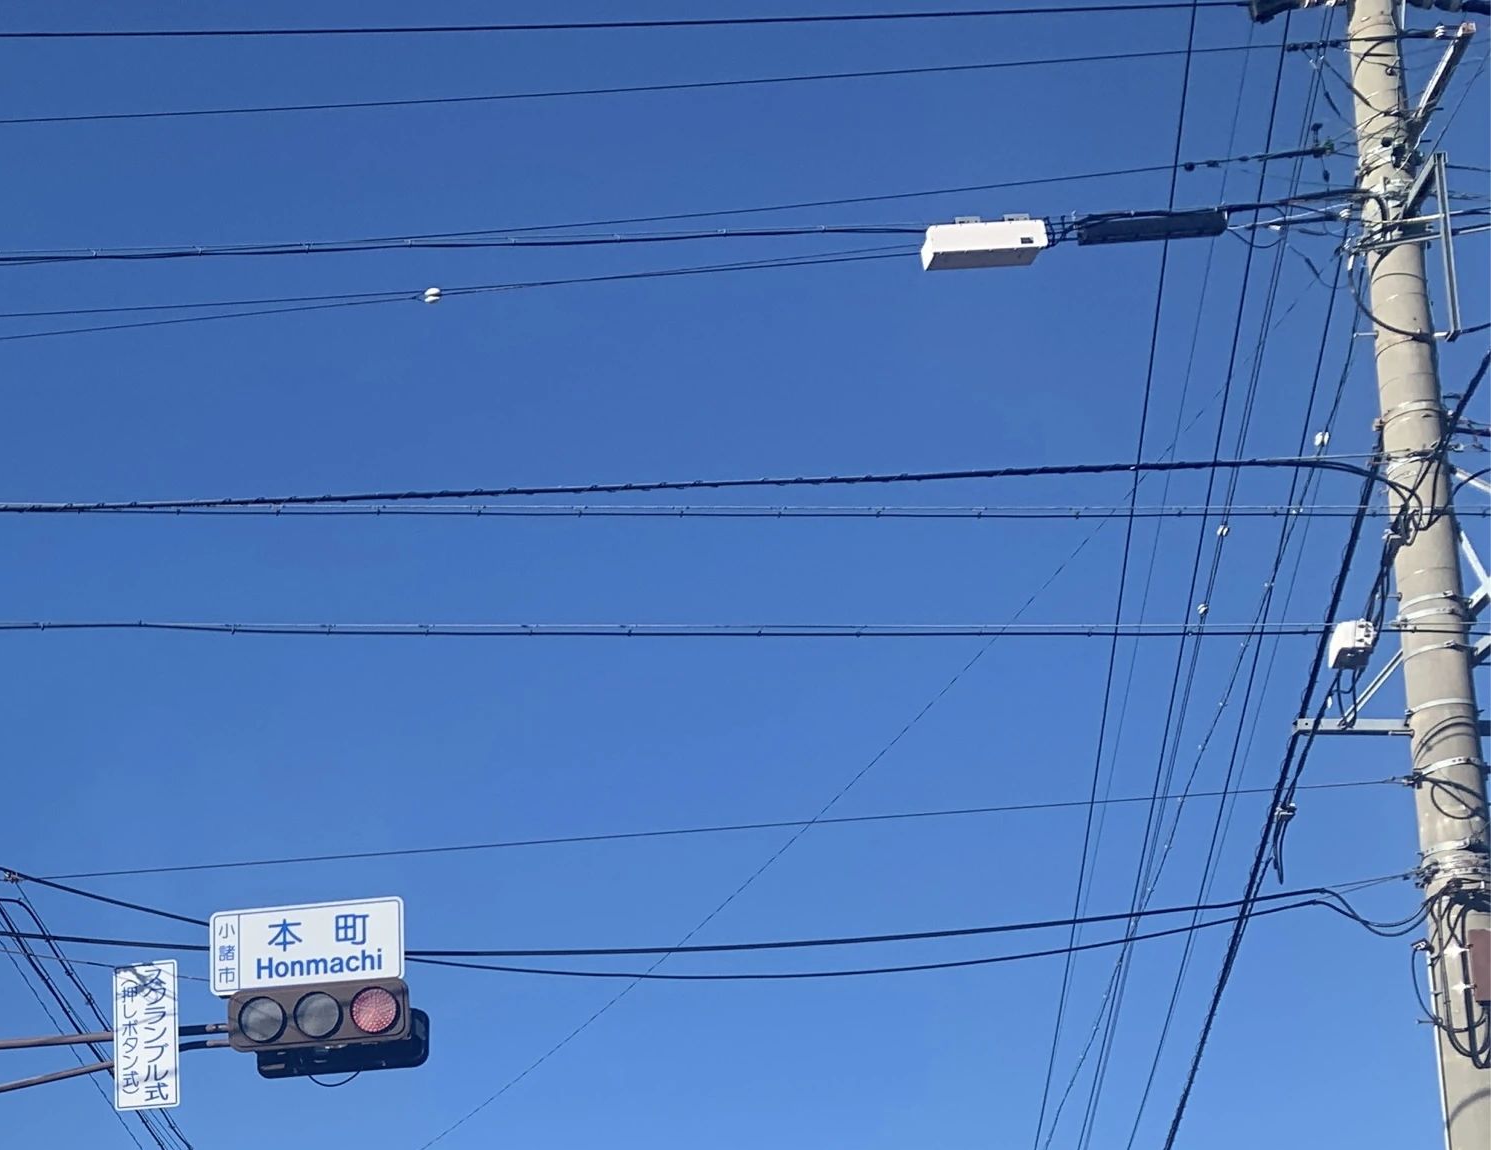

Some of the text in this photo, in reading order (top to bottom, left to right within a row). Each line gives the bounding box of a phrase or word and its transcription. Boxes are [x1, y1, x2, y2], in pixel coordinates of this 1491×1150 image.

[217, 921, 236, 984] 小諸市
[267, 913, 370, 952] 本町
[256, 949, 383, 980] Honmachi
[142, 967, 170, 1103] スクランブル式
